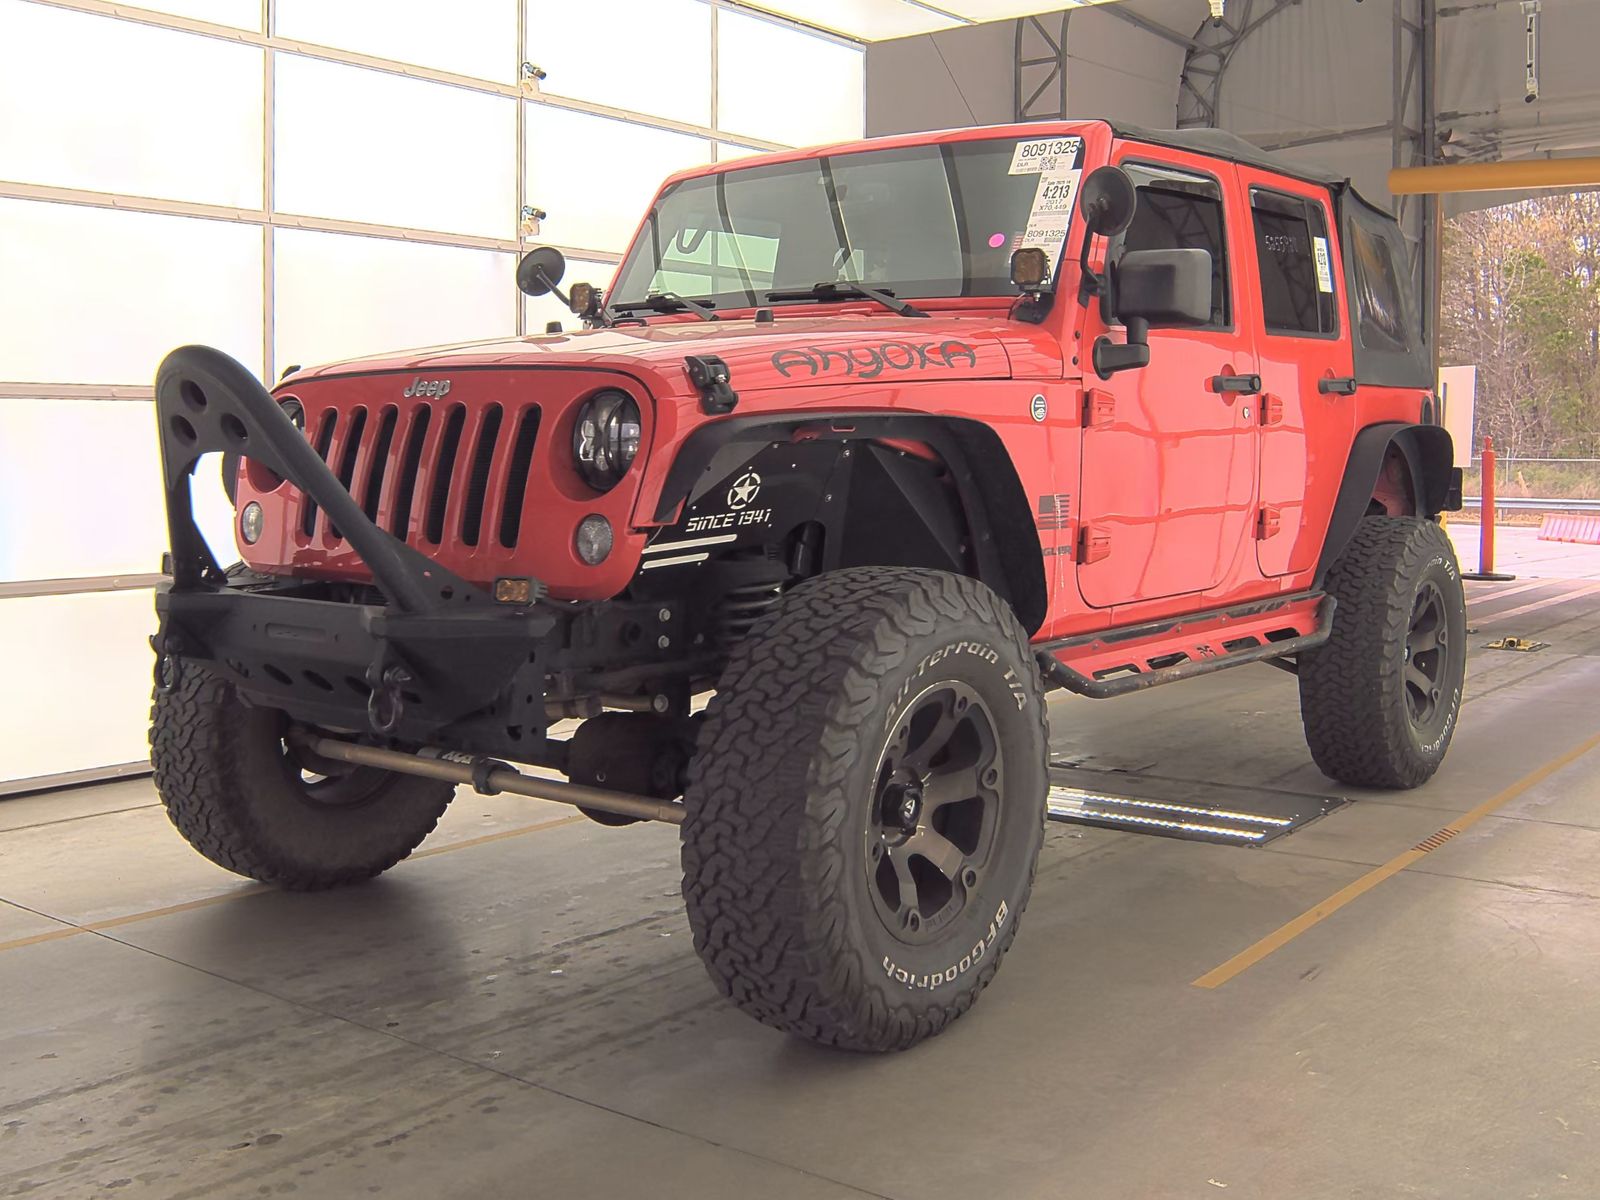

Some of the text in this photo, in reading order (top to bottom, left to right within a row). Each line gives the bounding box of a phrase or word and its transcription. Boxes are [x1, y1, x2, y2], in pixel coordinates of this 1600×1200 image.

[1022, 141, 1079, 158] 8091325
[1042, 184, 1071, 200] 4:213
[1027, 229, 1066, 238] 8091325
[403, 377, 451, 400] Jeep
[1003, 664, 1028, 711] T/A
[882, 899, 1009, 991] BFGoodrich
